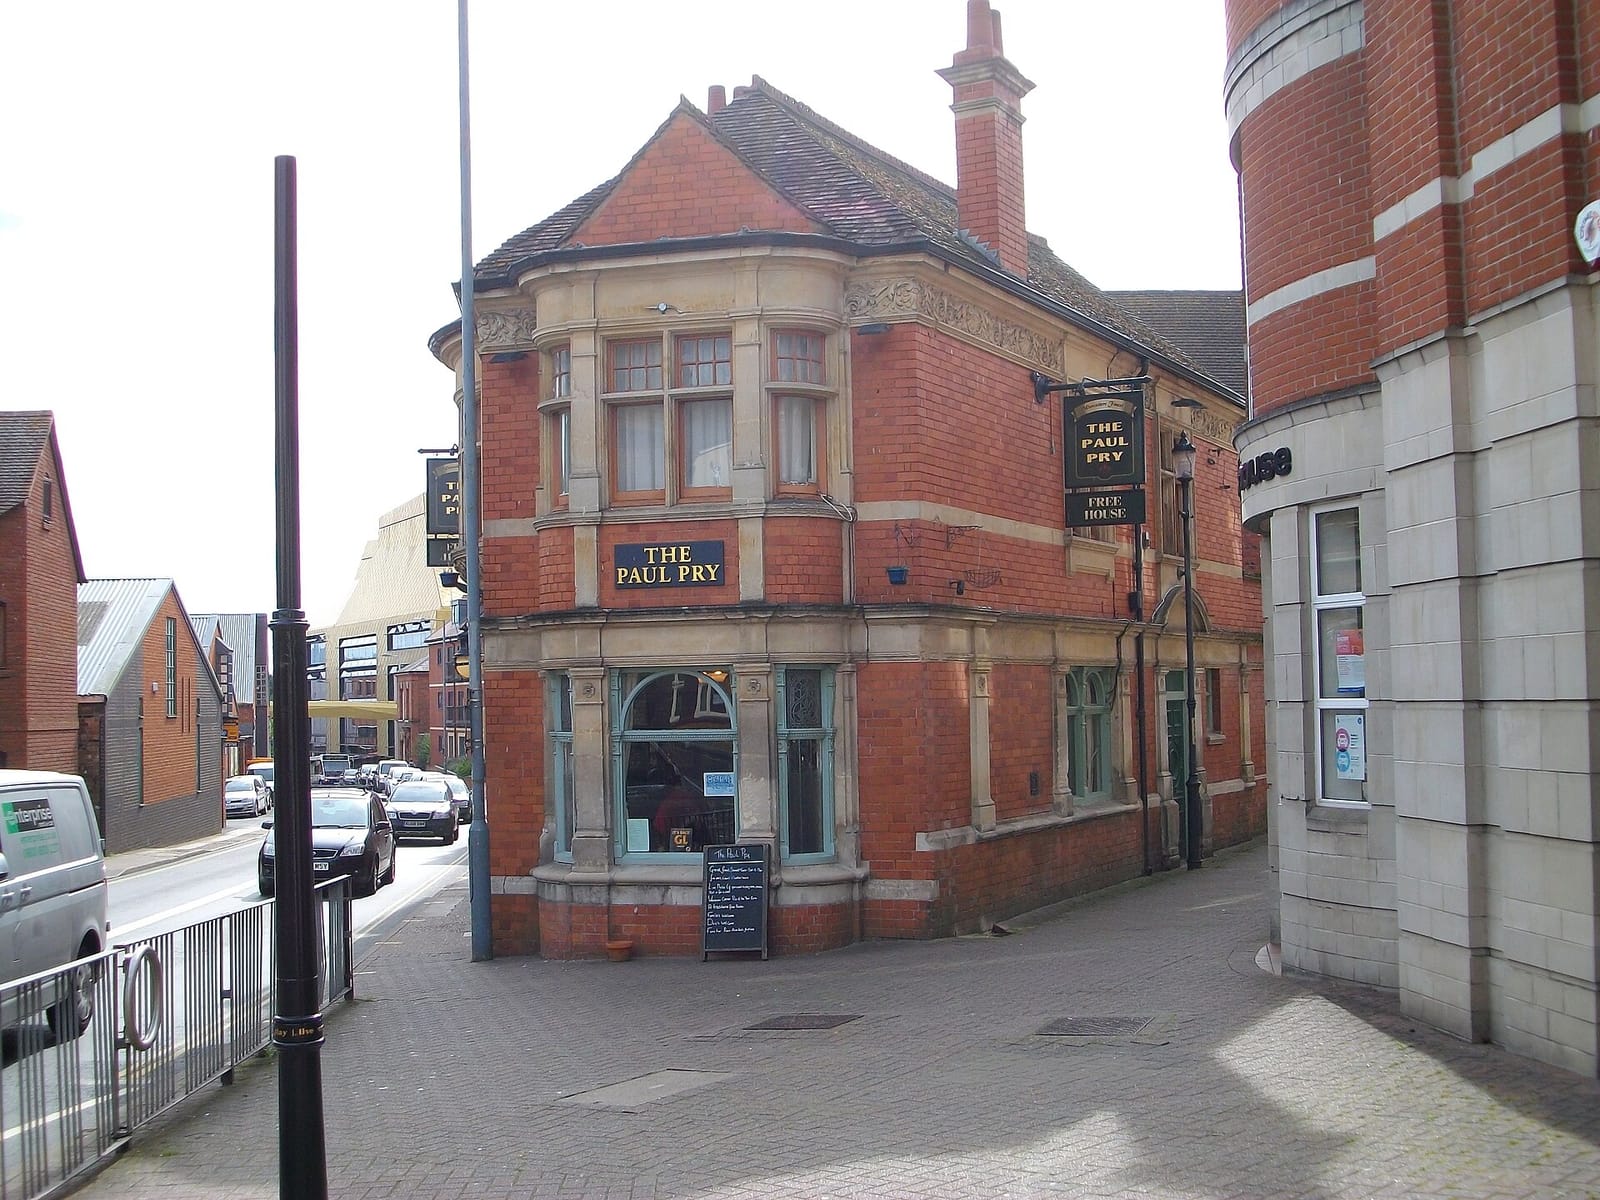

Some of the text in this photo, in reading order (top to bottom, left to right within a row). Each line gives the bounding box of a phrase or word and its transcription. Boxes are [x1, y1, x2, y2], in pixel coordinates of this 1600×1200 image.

[1086, 421, 1123, 434] THE
[1081, 436, 1129, 449] PAUL
[1086, 451, 1124, 464] PRY
[1088, 496, 1122, 508] FREE
[1084, 508, 1127, 521] HOUSE
[643, 546, 692, 564] THE
[617, 563, 720, 586] PAUL PRY
